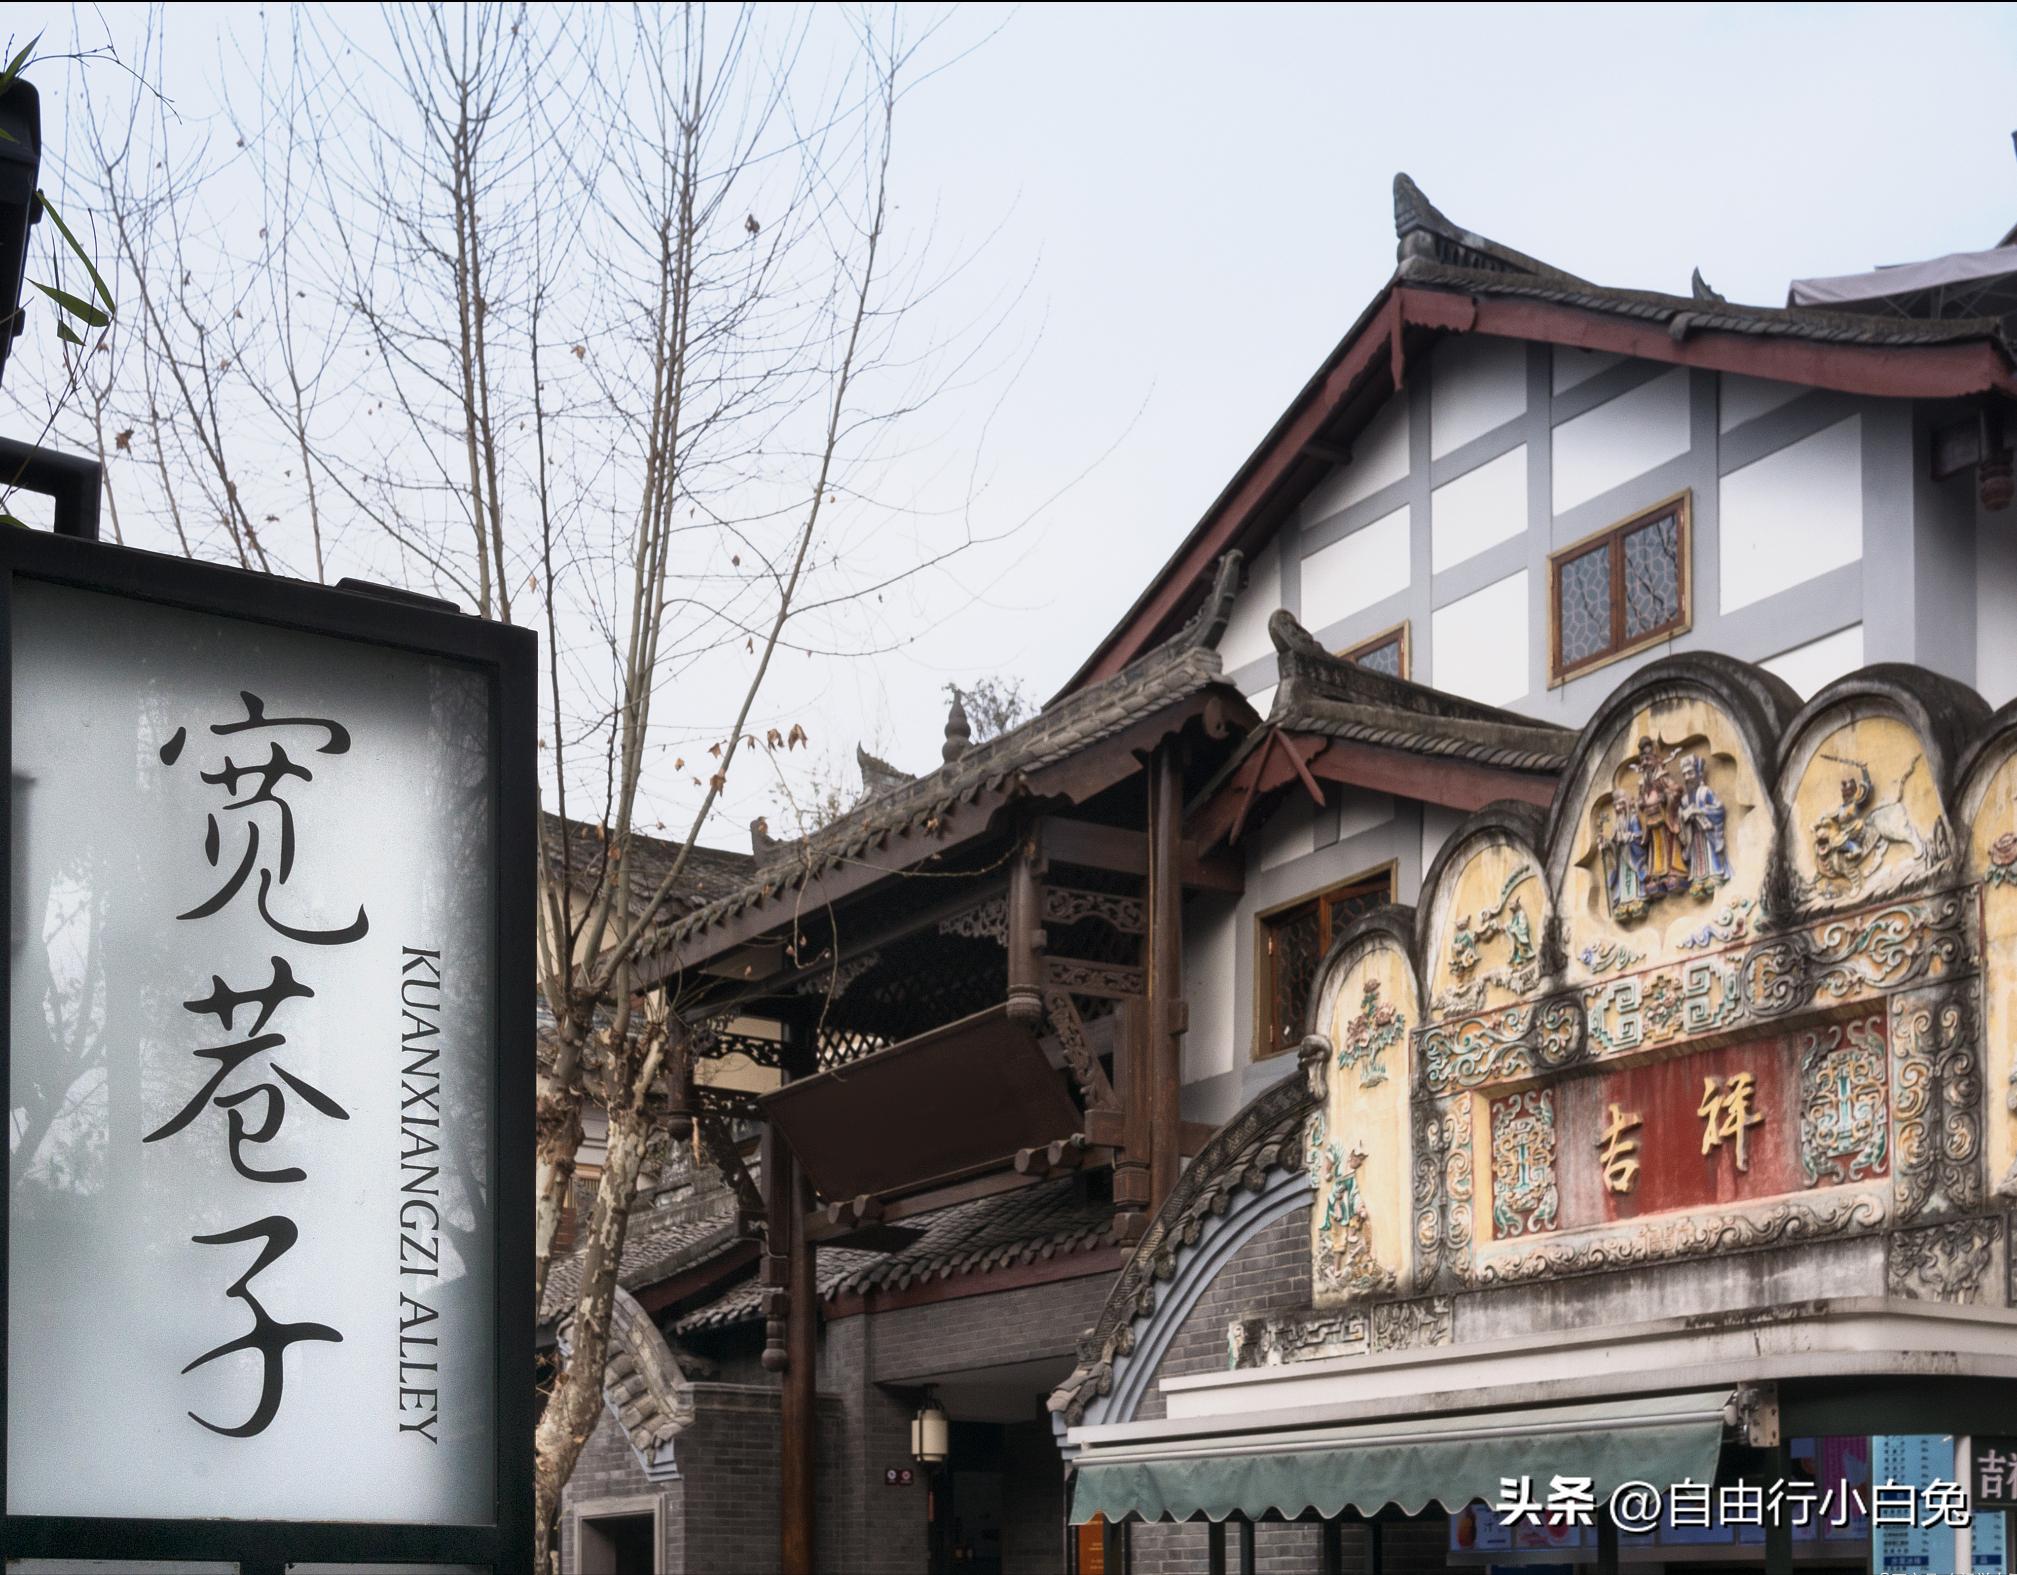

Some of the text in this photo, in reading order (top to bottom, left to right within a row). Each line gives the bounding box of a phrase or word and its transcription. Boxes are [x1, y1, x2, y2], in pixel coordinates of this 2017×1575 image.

[142, 690, 369, 1438] 宽巷子
[398, 944, 441, 1446] KUANXIANGZI ALLEY
[1598, 1071, 1764, 1194] 吉祥
